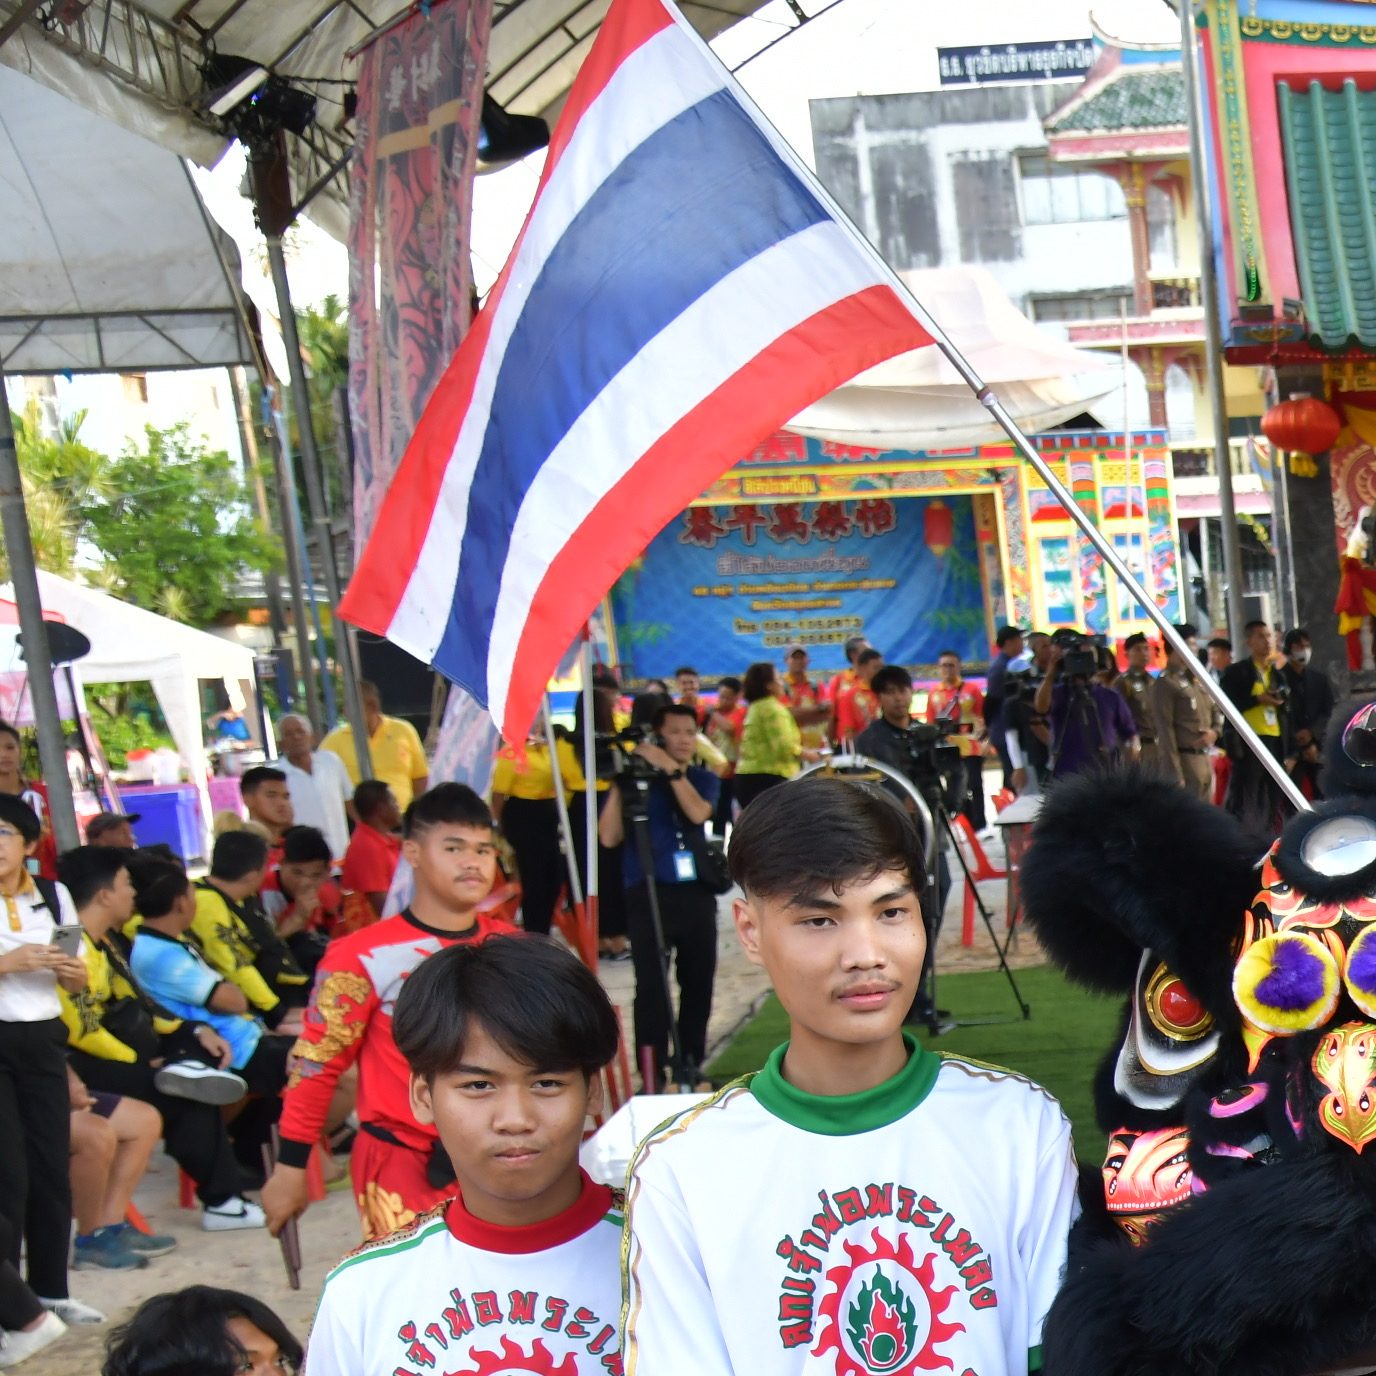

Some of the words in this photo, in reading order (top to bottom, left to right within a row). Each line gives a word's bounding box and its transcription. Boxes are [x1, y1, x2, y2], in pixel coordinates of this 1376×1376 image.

[776, 1182, 998, 1349] ลกเจ้าพ่อพระเพลง
